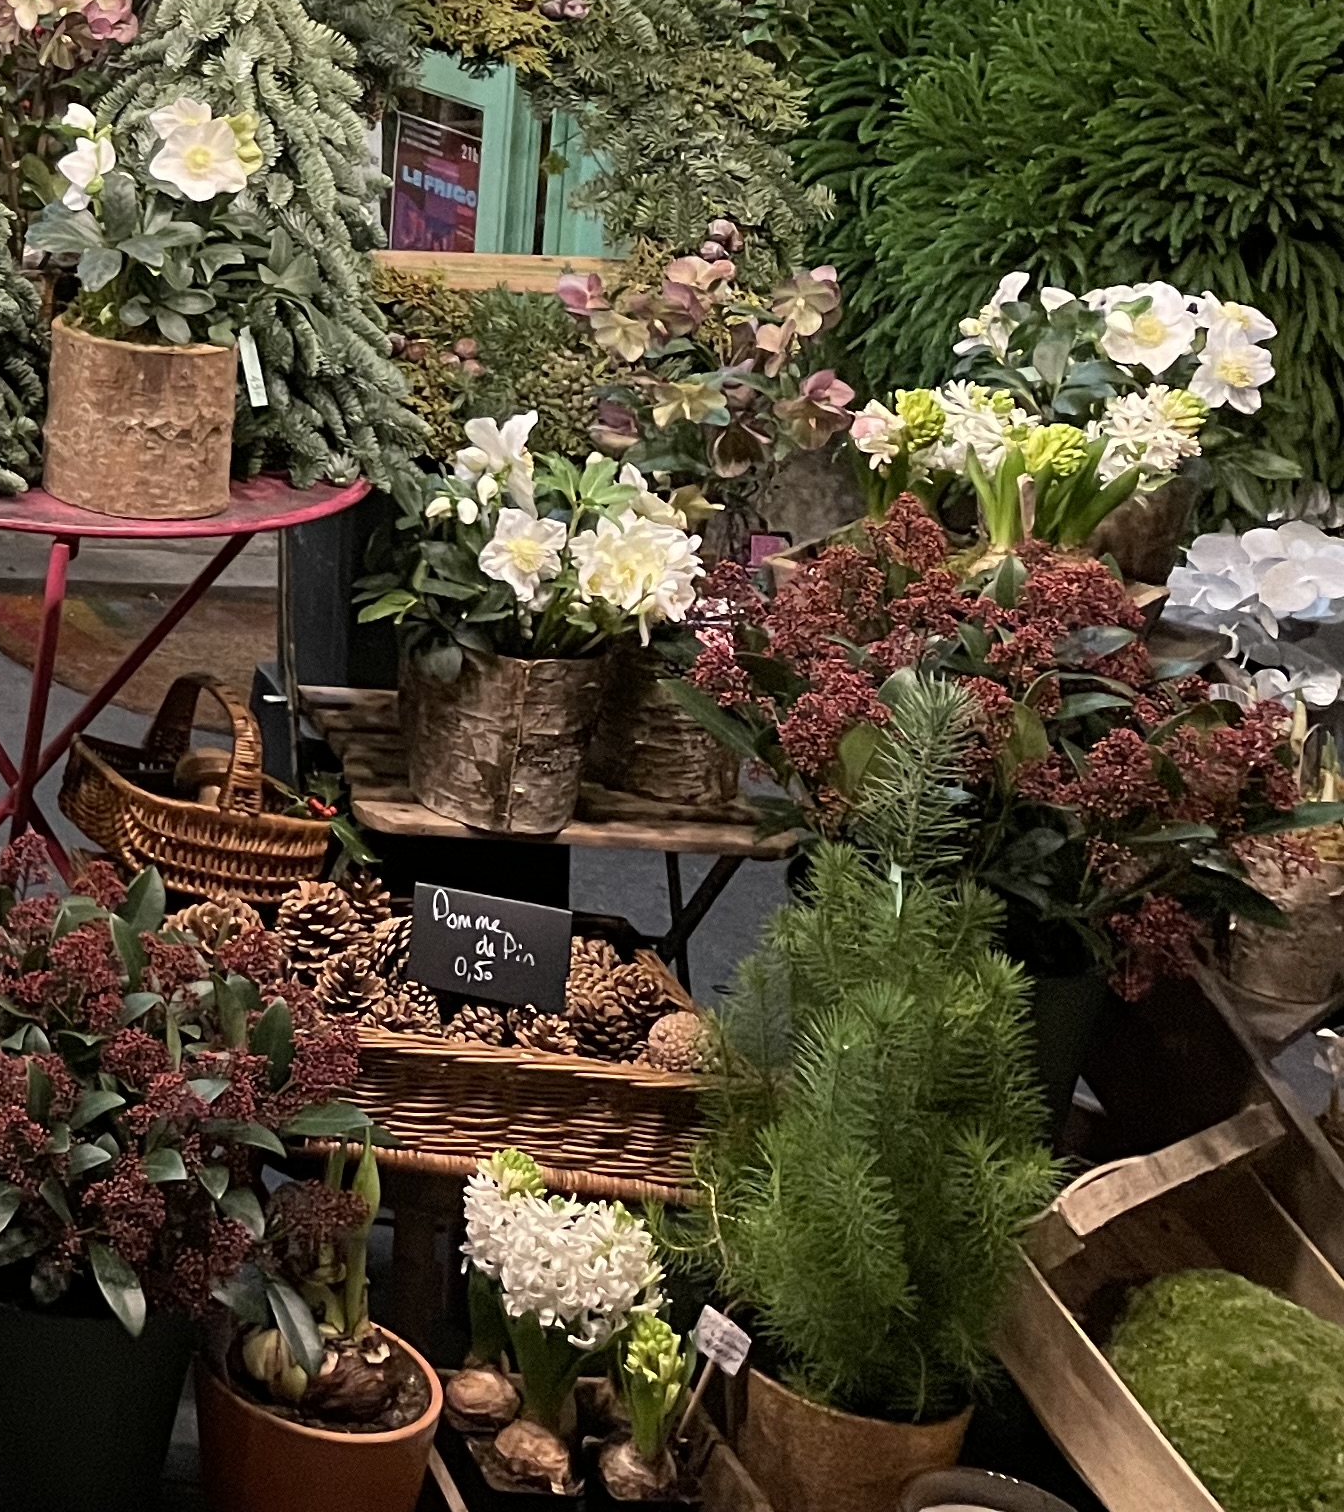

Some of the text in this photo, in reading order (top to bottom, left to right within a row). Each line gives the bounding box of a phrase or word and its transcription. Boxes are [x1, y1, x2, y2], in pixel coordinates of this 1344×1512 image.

[402, 164, 423, 188] LE
[423, 173, 477, 208] FRIGO
[432, 888, 506, 933] Pomme
[475, 931, 535, 966] de Pin
[454, 956, 494, 983] 0,50
